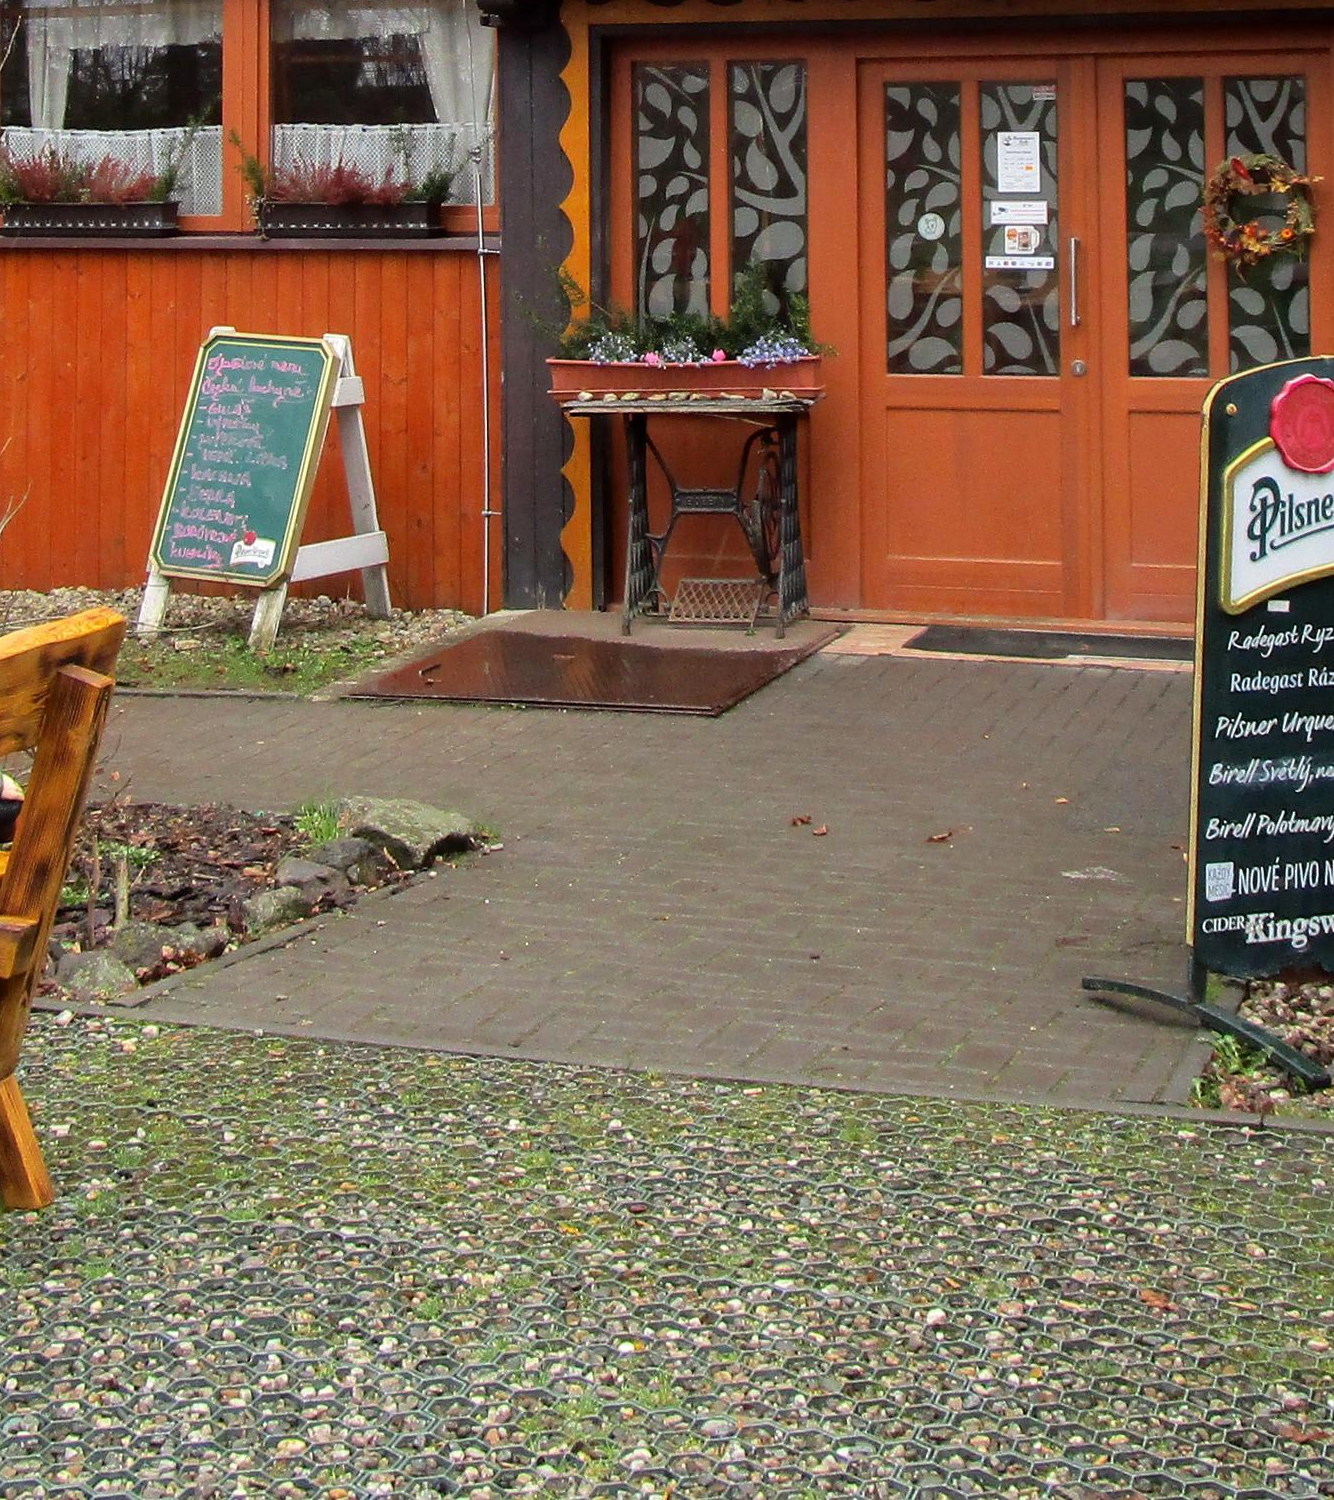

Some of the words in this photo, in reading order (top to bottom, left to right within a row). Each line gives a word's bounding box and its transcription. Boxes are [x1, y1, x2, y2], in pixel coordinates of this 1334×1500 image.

[1228, 625, 1299, 658] Radegast
[1230, 668, 1303, 694] Radegast
[1215, 711, 1278, 740] Pilsner
[1209, 756, 1259, 785] Birell
[1259, 756, 1314, 792] Světlý,
[1205, 812, 1256, 840] Birell
[1238, 856, 1280, 895] NOVÉ
[1284, 861, 1320, 889] PIVO
[1202, 915, 1246, 933] CIDER
